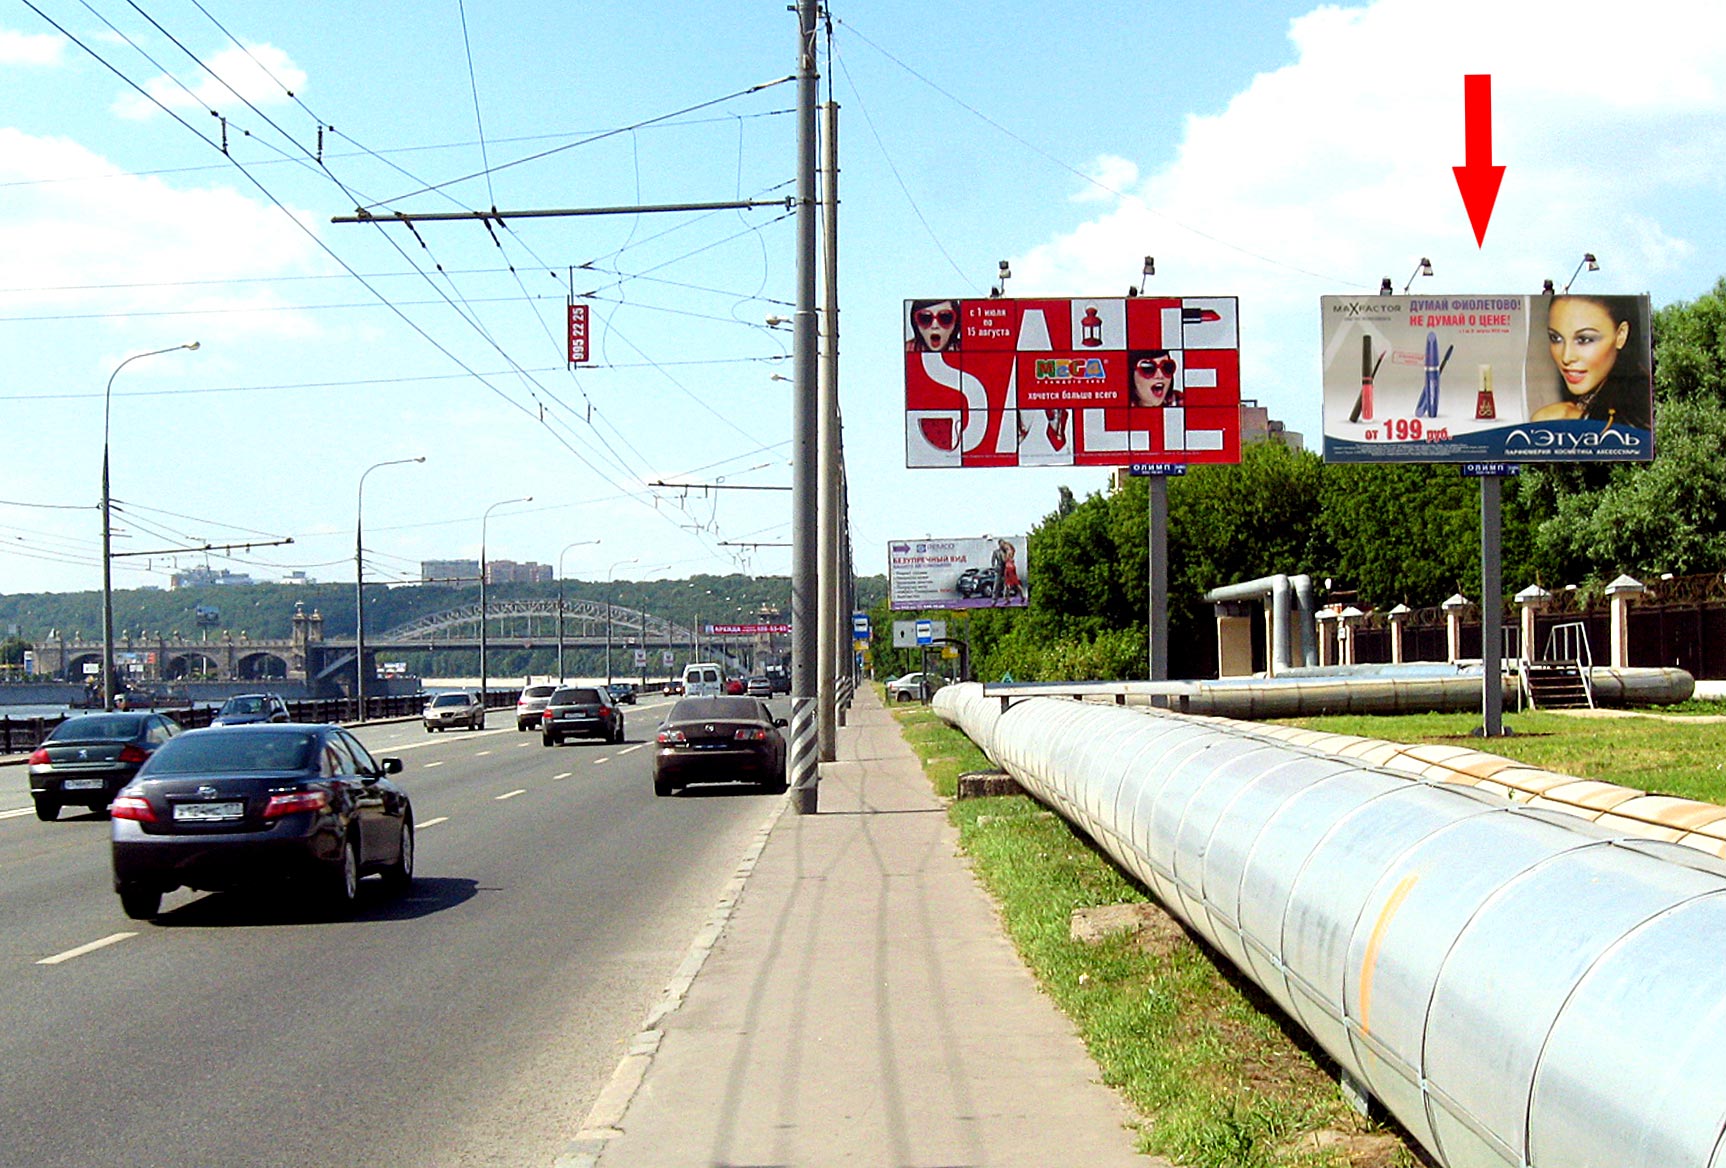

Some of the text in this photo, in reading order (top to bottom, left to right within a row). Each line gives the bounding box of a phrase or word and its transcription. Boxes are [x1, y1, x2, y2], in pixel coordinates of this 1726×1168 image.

[1410, 298, 1521, 312] ДУМАЙ ФИОЛЕТОВО!
[1409, 312, 1511, 328] НЕ ДУМАЙ О ЦЕНЕ!
[967, 326, 1010, 339] 15 августа
[572, 338, 584, 360] 995
[1028, 389, 1118, 400] хочется больше всего
[1365, 418, 1453, 443] от 199 руб.
